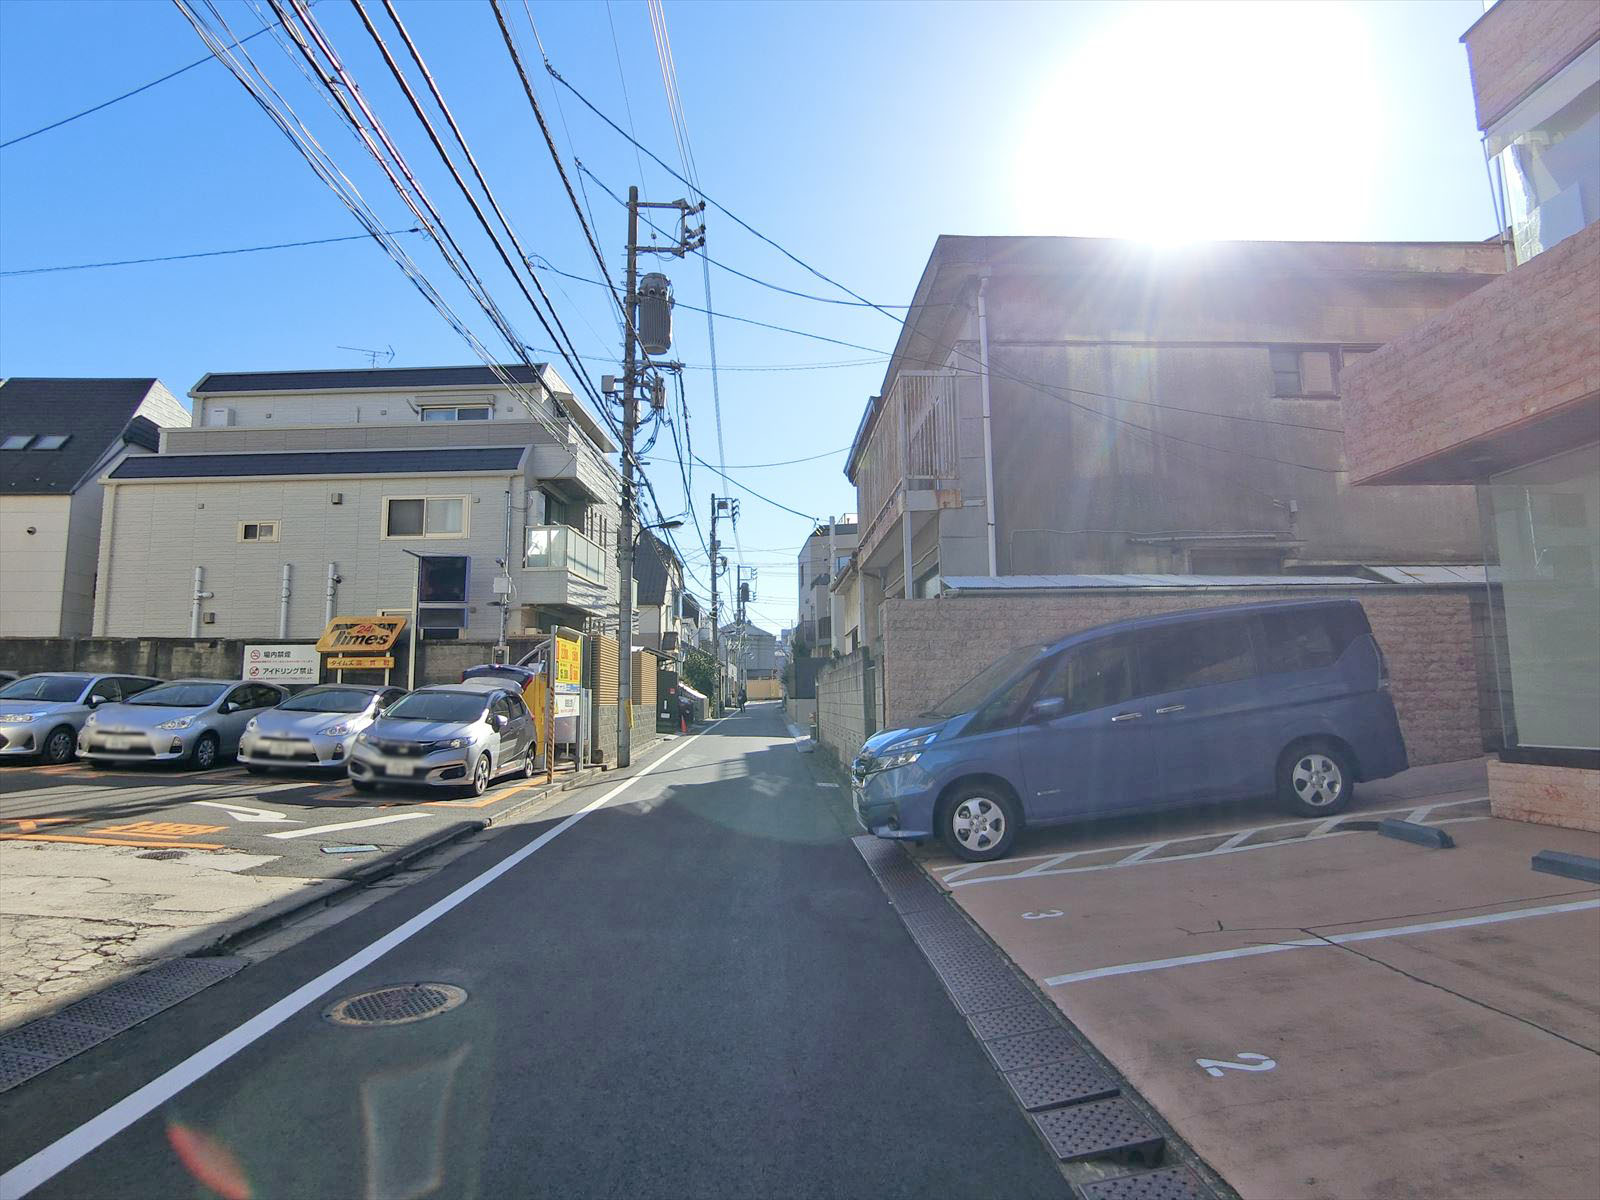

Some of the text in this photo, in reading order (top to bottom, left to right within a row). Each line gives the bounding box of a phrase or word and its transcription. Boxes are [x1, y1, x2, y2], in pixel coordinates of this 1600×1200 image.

[331, 625, 395, 648] Times
[262, 666, 314, 675] アイドリング禁止
[1022, 909, 1064, 920] 3
[1195, 1052, 1276, 1077] 2
